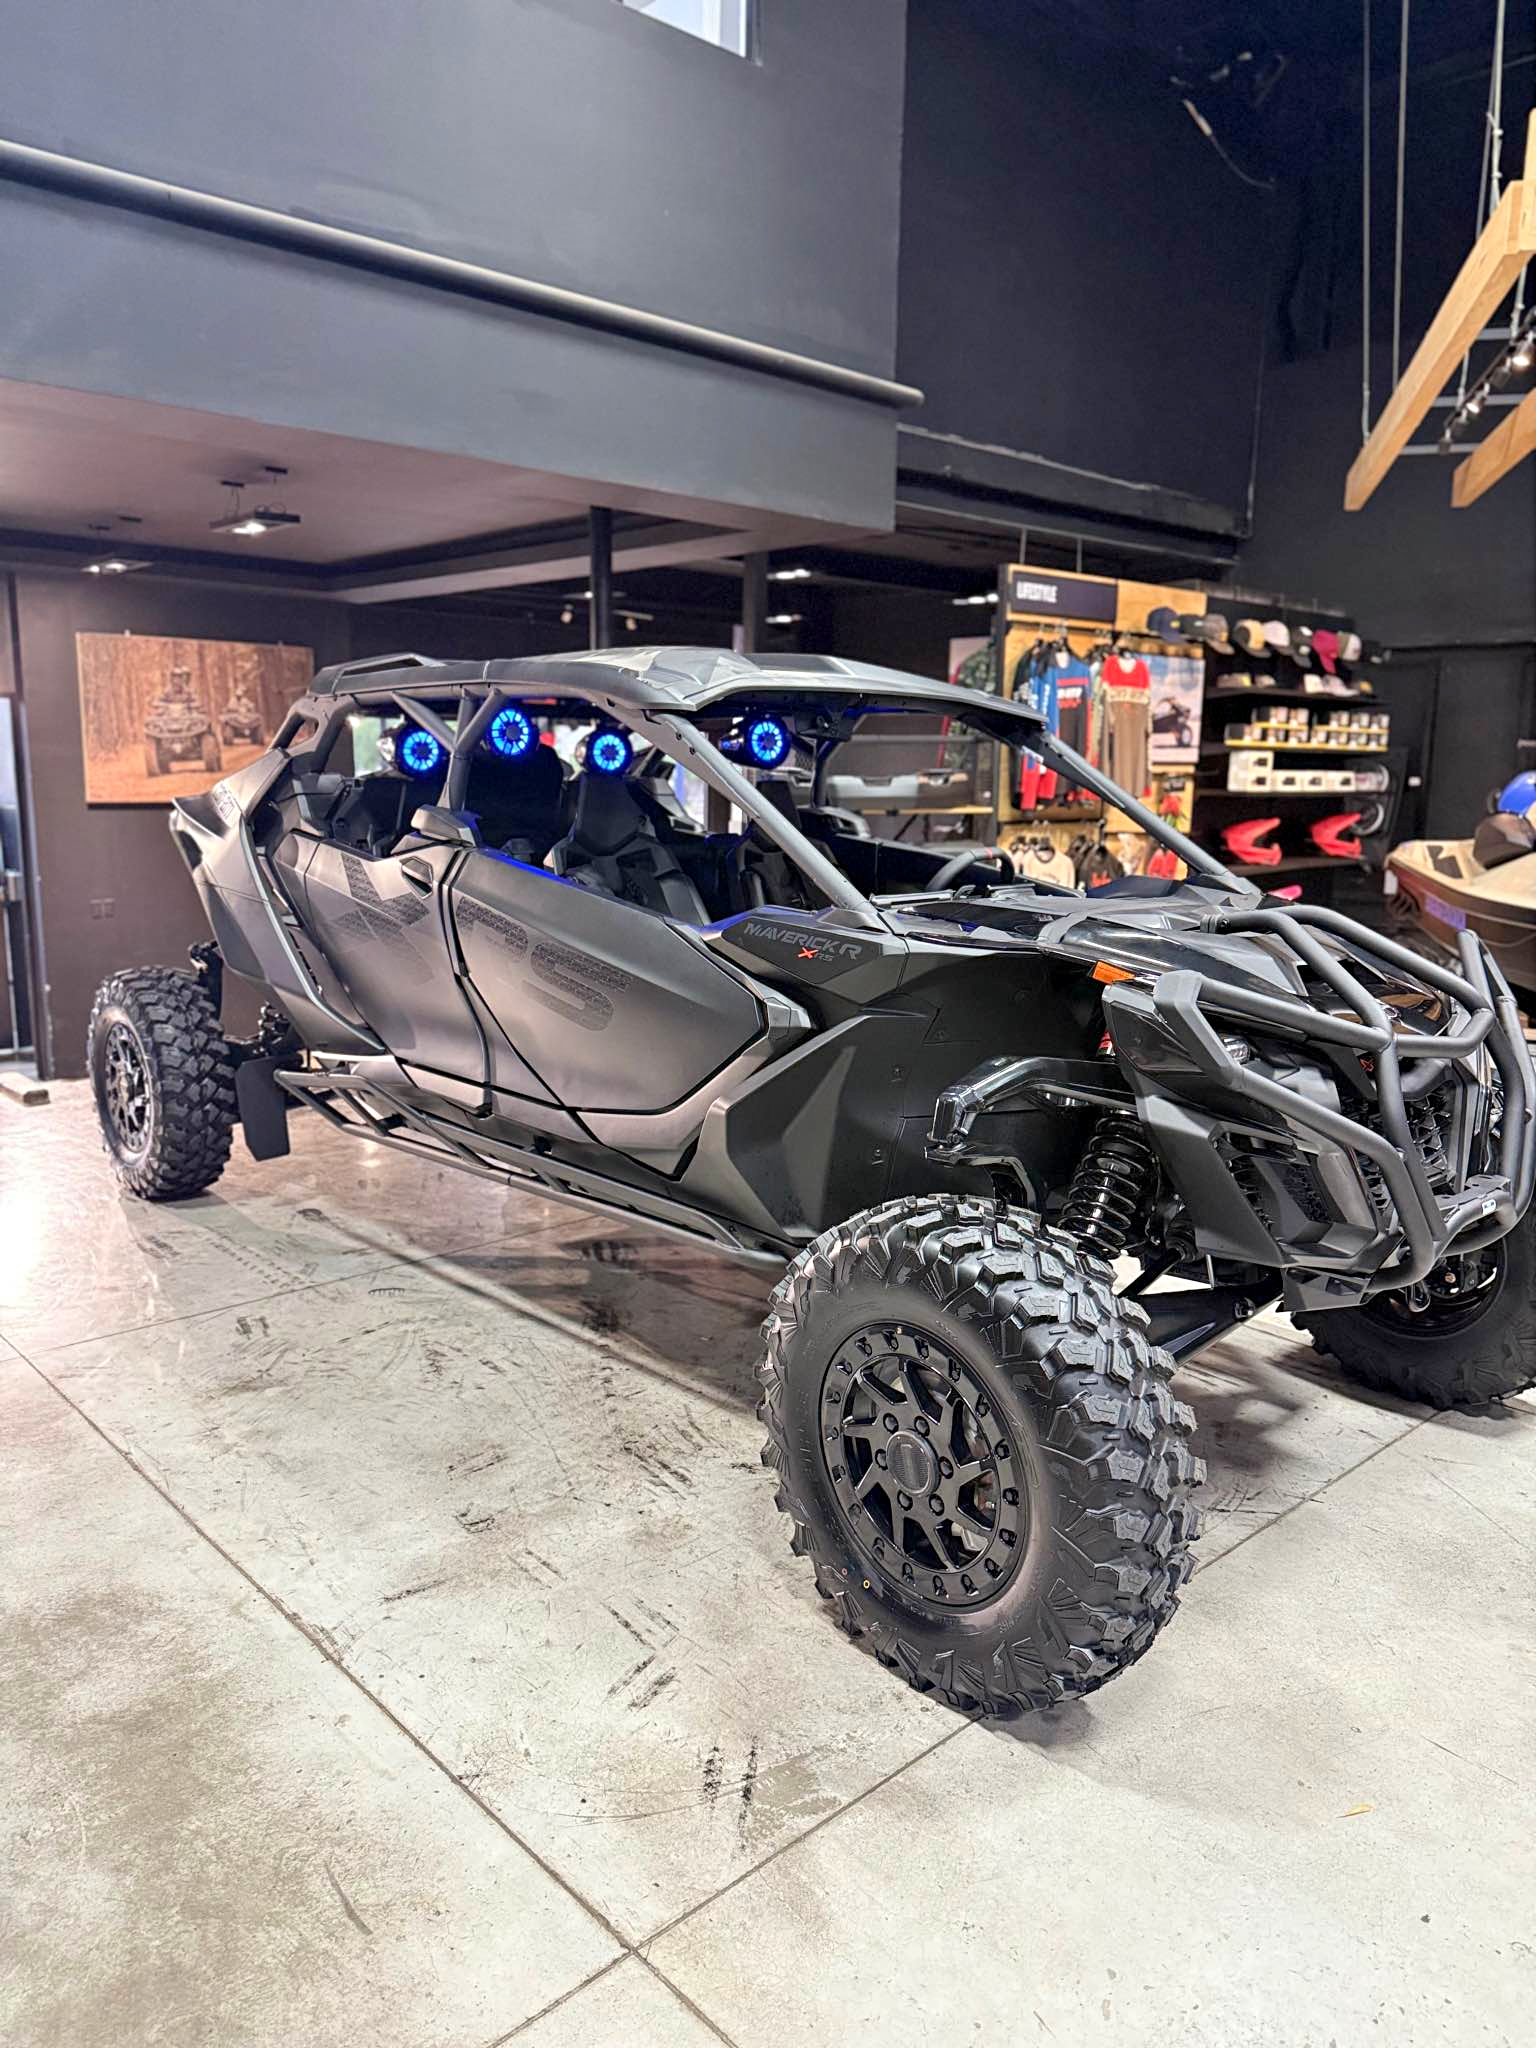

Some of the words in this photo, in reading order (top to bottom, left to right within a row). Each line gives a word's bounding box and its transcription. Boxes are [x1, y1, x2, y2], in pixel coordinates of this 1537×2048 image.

[1016, 581, 1057, 603] LIFESTYLE
[744, 923, 840, 952] MAVERICK
[839, 944, 862, 960] R
